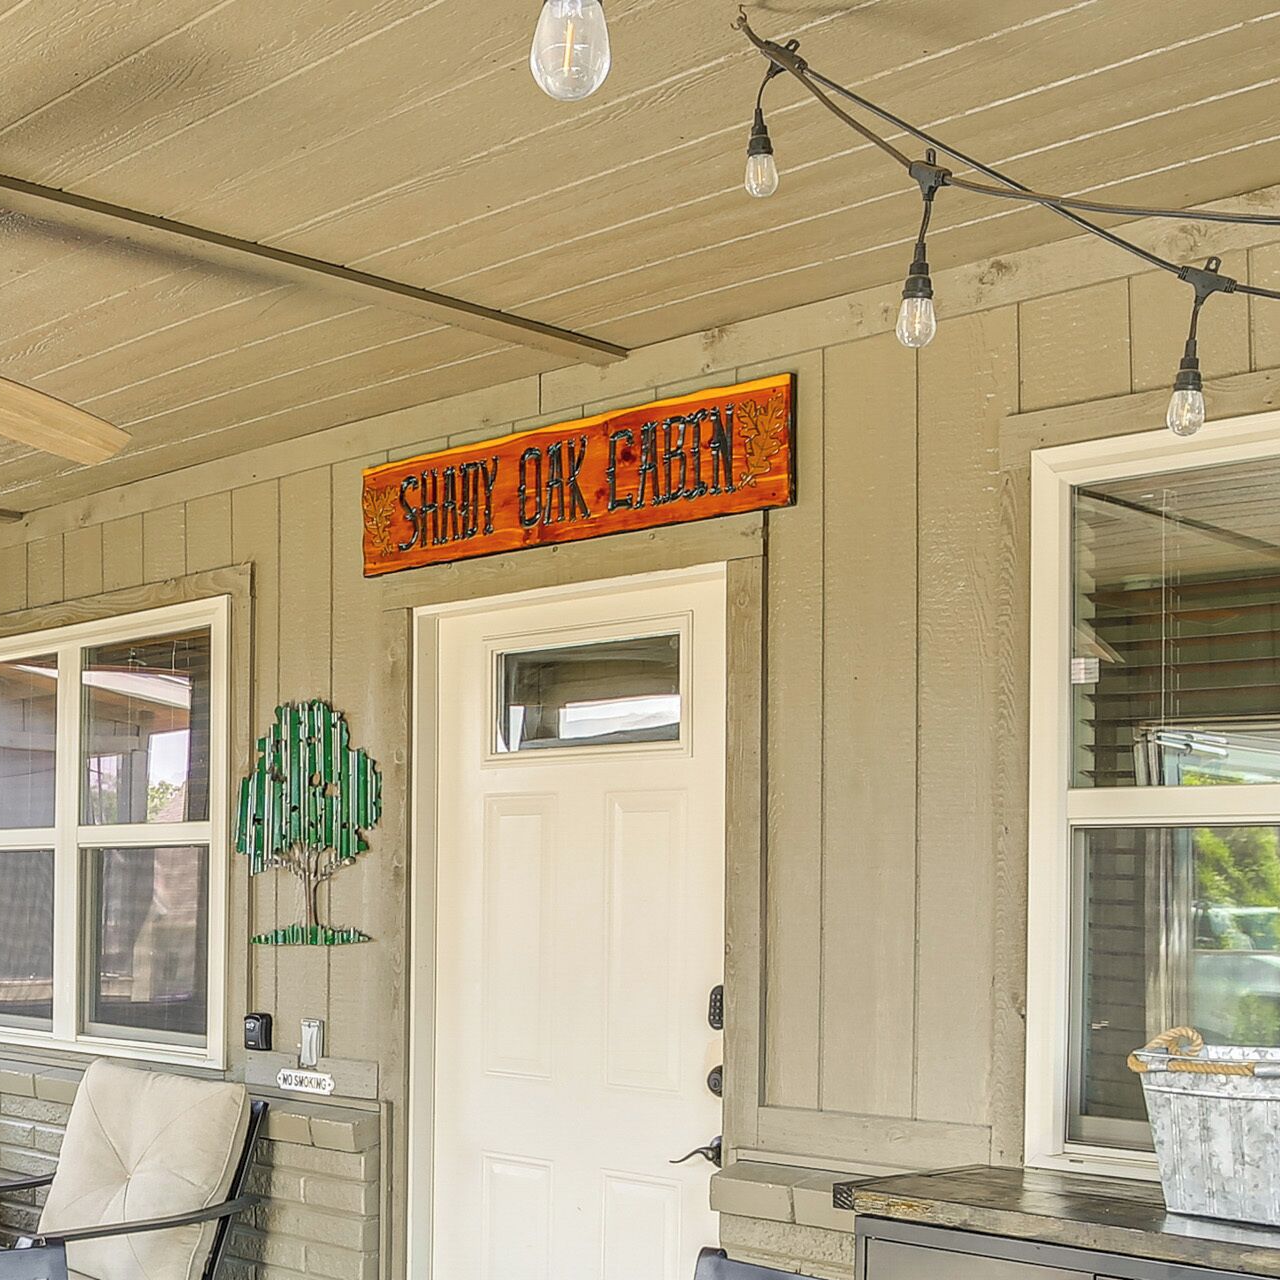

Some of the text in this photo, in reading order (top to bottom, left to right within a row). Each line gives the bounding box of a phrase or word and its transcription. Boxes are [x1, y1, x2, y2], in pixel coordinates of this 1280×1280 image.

[397, 402, 737, 552] SHADY OAK CABIN
[282, 1073, 327, 1090] NO SMOKING
